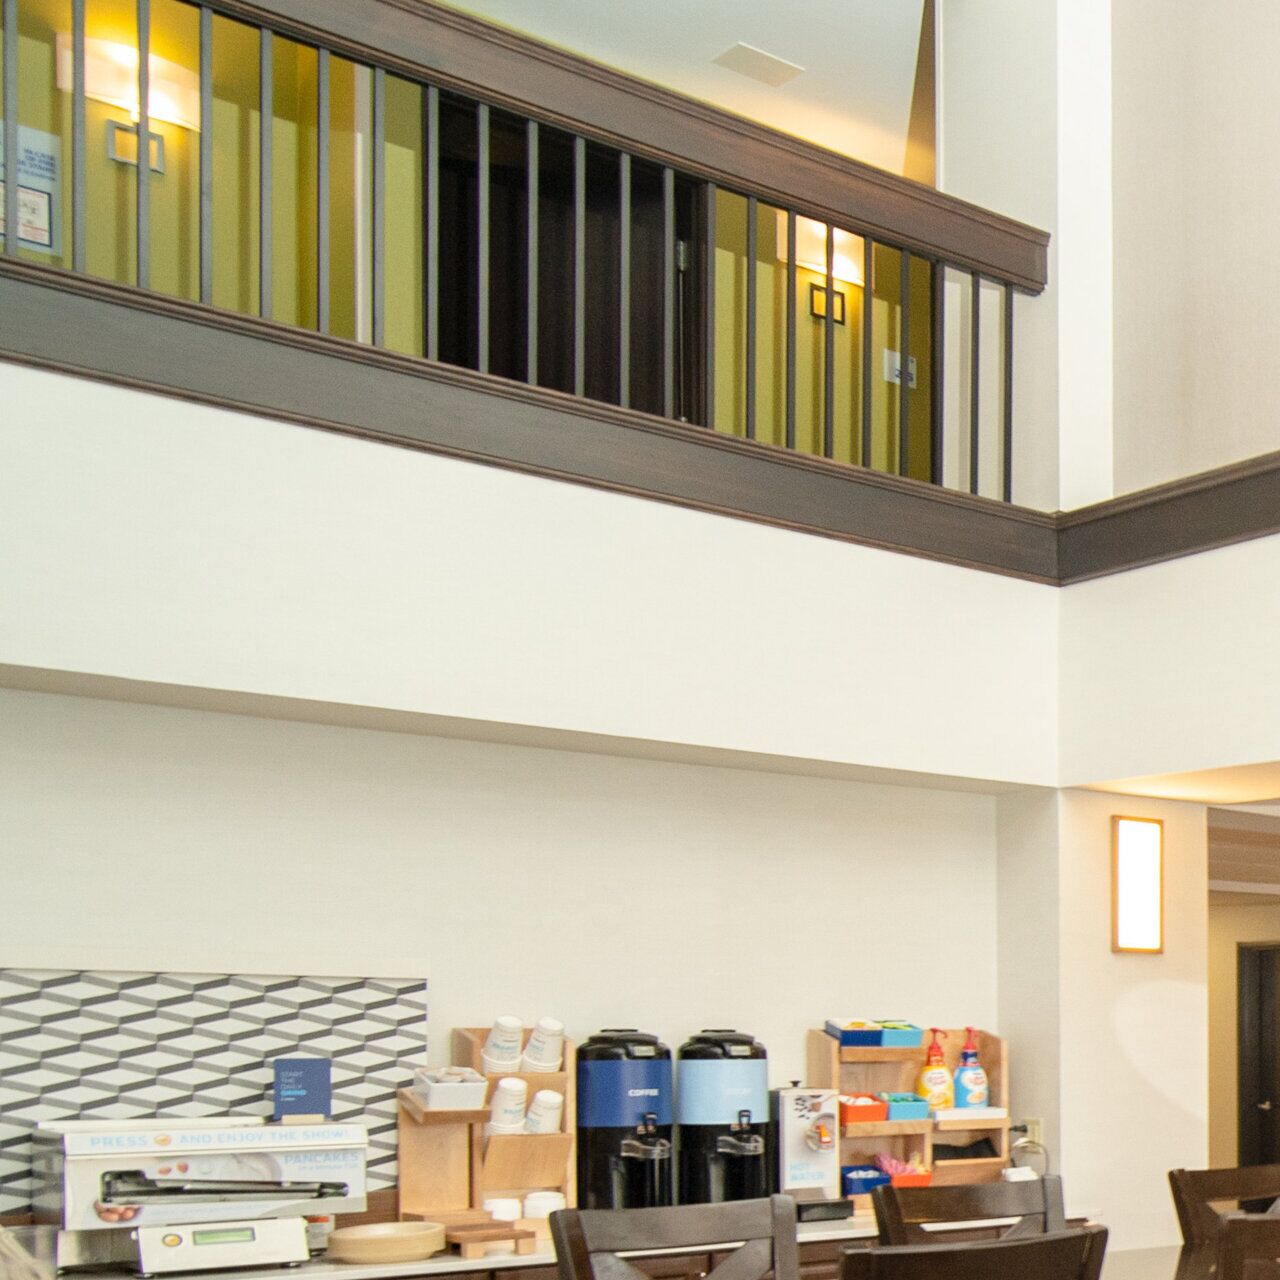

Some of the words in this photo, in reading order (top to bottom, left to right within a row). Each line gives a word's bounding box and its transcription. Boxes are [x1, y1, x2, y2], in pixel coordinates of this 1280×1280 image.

[628, 1088, 660, 1098] COFFEE
[89, 1135, 149, 1148] PRESS
[179, 1133, 213, 1145] AND
[217, 1131, 264, 1143] ENJOY
[270, 1130, 298, 1141] THE
[302, 1128, 350, 1139] SHOW!
[284, 1151, 359, 1165] PANCAKES
